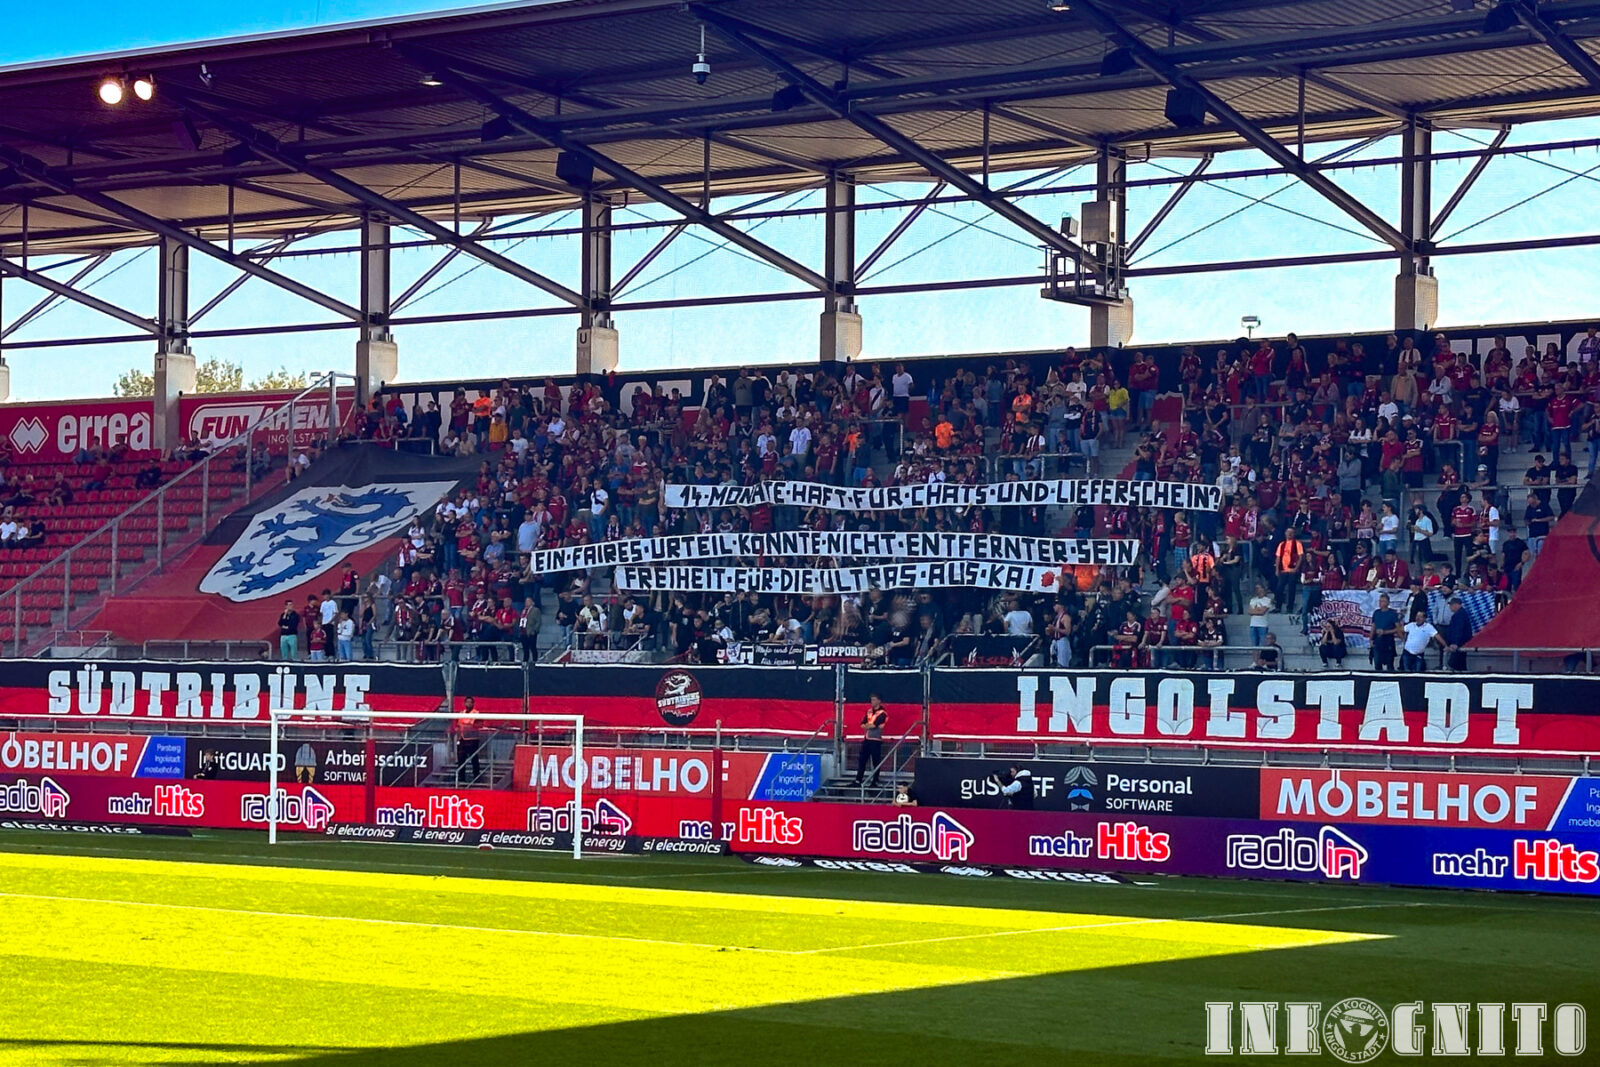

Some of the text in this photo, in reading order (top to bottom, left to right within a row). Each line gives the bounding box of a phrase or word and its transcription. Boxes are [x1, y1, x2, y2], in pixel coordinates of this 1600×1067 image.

[579, 332, 588, 344] U
[157, 358, 163, 369] T
[57, 411, 151, 454] errea
[200, 415, 250, 440] FUN
[680, 485, 703, 506] 14
[708, 481, 786, 506] MONATE
[792, 484, 847, 508] HAFT
[911, 485, 989, 506] CHATS
[997, 481, 1049, 503] UND
[1056, 479, 1221, 511] LIEFERSCHEIN?
[535, 550, 566, 572] EIN
[572, 540, 643, 567] FAIRES
[651, 535, 733, 560] URTEIL
[827, 533, 897, 555] NICHT
[906, 533, 1068, 563] ENTFERNTER
[1075, 540, 1135, 564] SEIN
[624, 562, 1035, 592] FREIHEIT FÜR DIE ULTRAS AUS KA!
[818, 646, 884, 657] SUPPORTS
[48, 663, 372, 721] SÜDTRIBÜNE
[1016, 676, 1534, 745] INGOLSTADT
[199, 750, 286, 771] litGUARD
[324, 749, 427, 768] Arbeischutz
[323, 770, 368, 782] SOFTWAR
[1106, 773, 1193, 795] Personal
[960, 776, 1055, 800] guSFF
[108, 784, 205, 817] mehr Hits
[376, 795, 485, 829] mehr Hits
[1105, 798, 1173, 812] SOFTWARE
[338, 824, 395, 839] electronics
[424, 831, 465, 843] energy
[679, 806, 803, 845] mer Hits
[492, 834, 555, 846] electronics
[584, 837, 626, 851] energy
[655, 839, 721, 854] electronics
[1028, 821, 1171, 862] mehr Hits
[1433, 838, 1600, 884] mehr Hits
